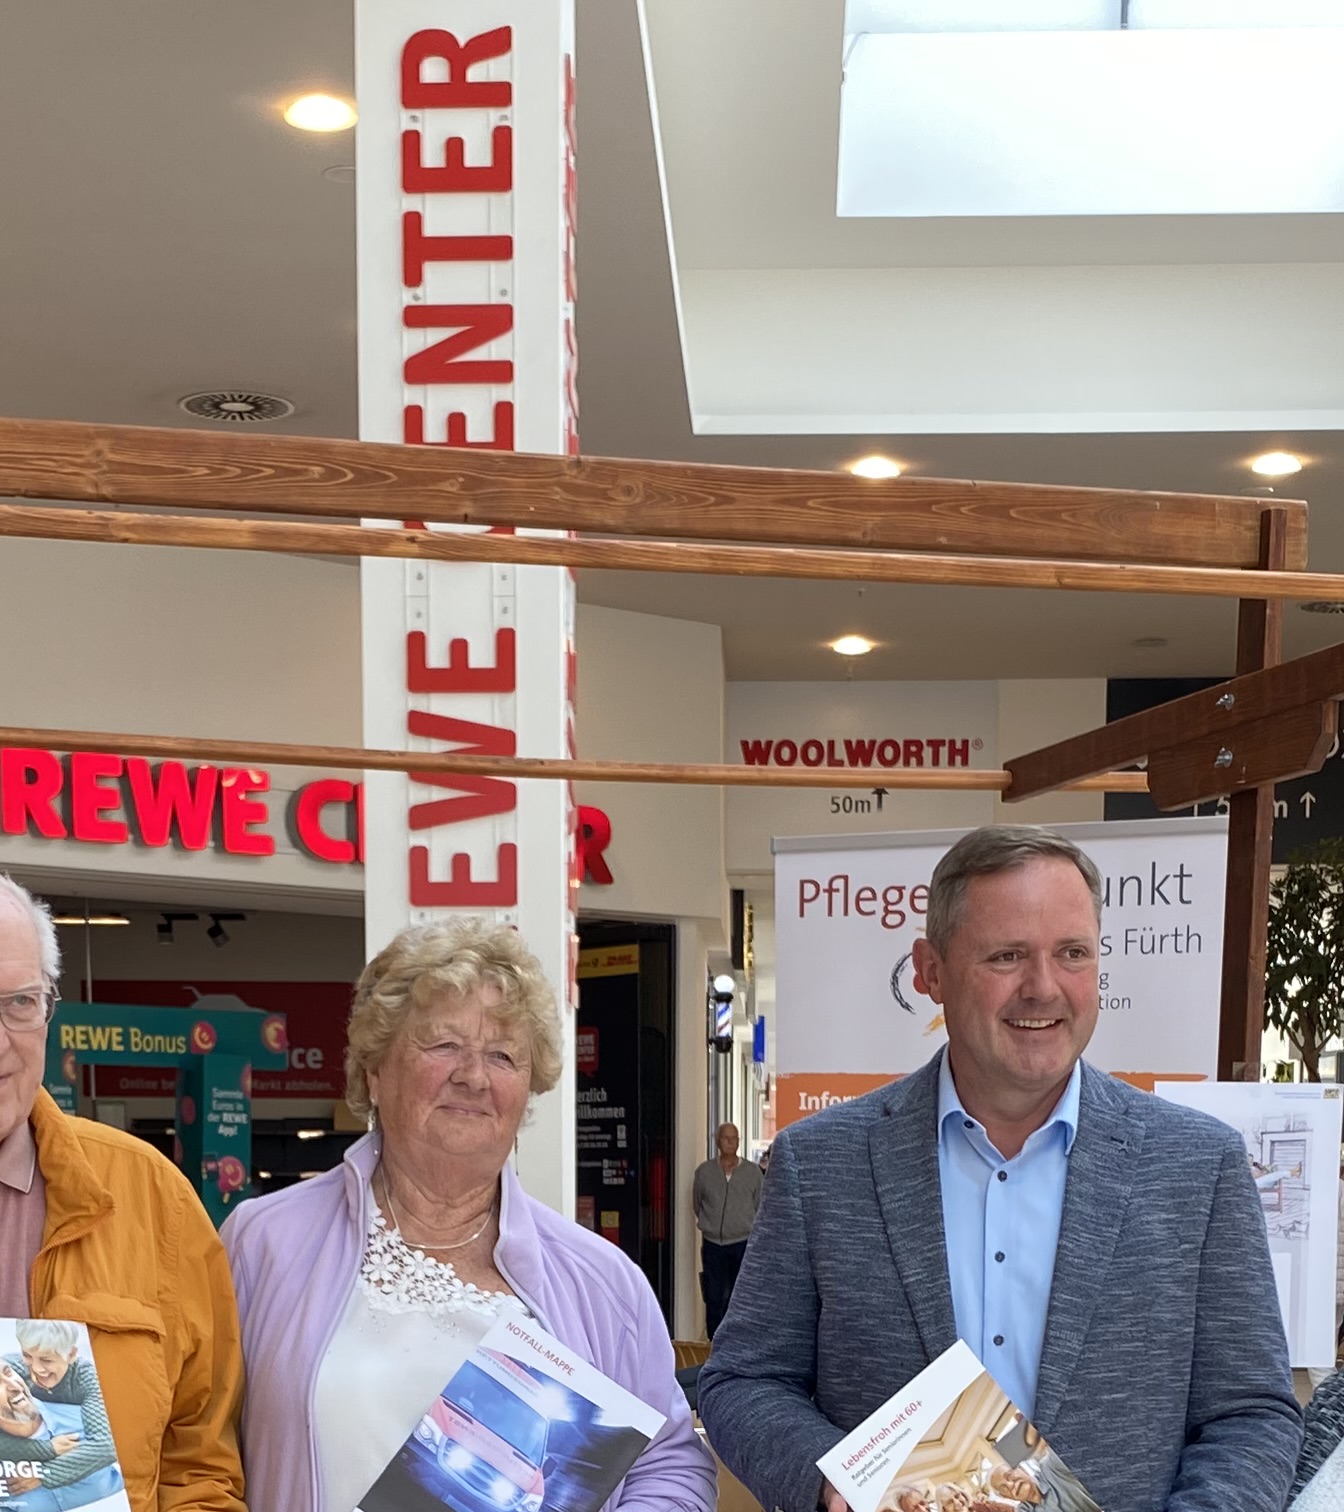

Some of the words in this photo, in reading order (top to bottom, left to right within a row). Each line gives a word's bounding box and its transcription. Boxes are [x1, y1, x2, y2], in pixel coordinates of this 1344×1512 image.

[830, 795, 872, 814] 50m
[1125, 924, 1202, 956] Fürth
[60, 1024, 125, 1052] REWE
[130, 1027, 187, 1054] Bonus
[506, 1321, 576, 1377] NOTFALL-MAPPE
[841, 1427, 892, 1471] Lebensfroh
[890, 1413, 907, 1430] mit
[904, 1400, 923, 1417] 60+
